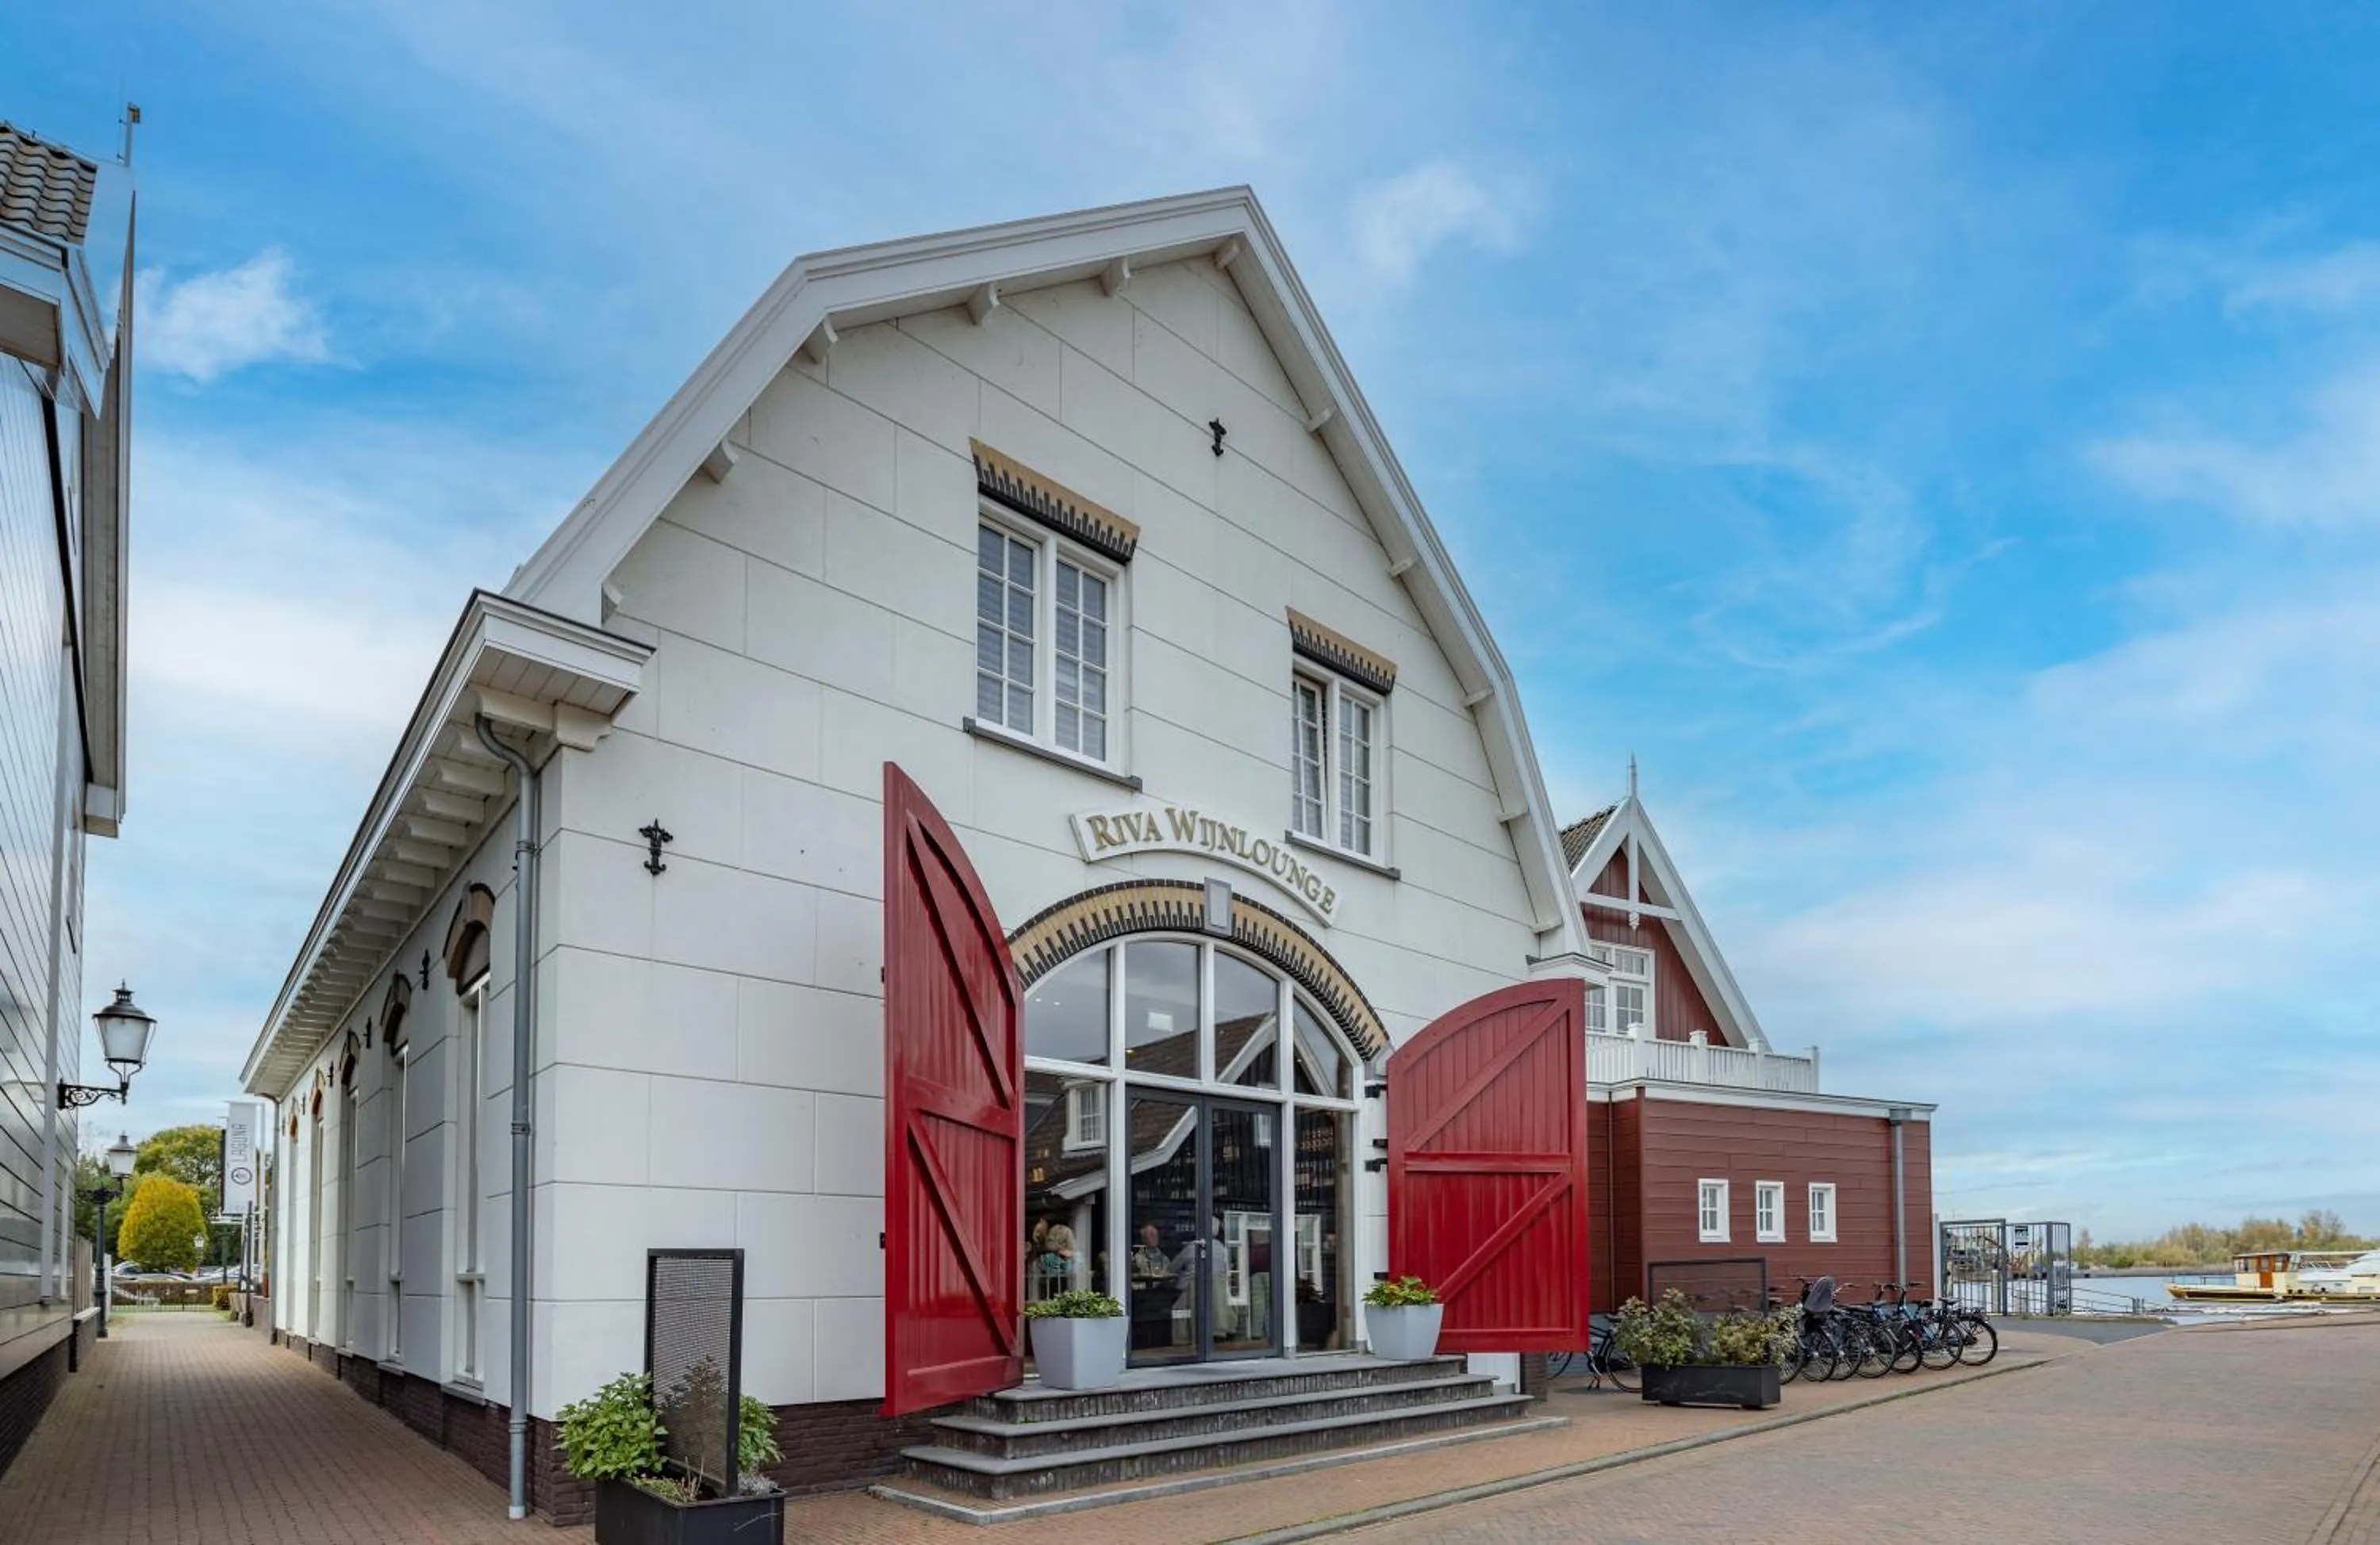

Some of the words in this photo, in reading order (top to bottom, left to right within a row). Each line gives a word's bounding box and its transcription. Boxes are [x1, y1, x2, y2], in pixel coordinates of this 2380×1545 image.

[1086, 811, 1163, 851] RIVA
[1165, 807, 1336, 914] WIJNLOUNGE
[231, 1123, 248, 1162] LAGUNA
